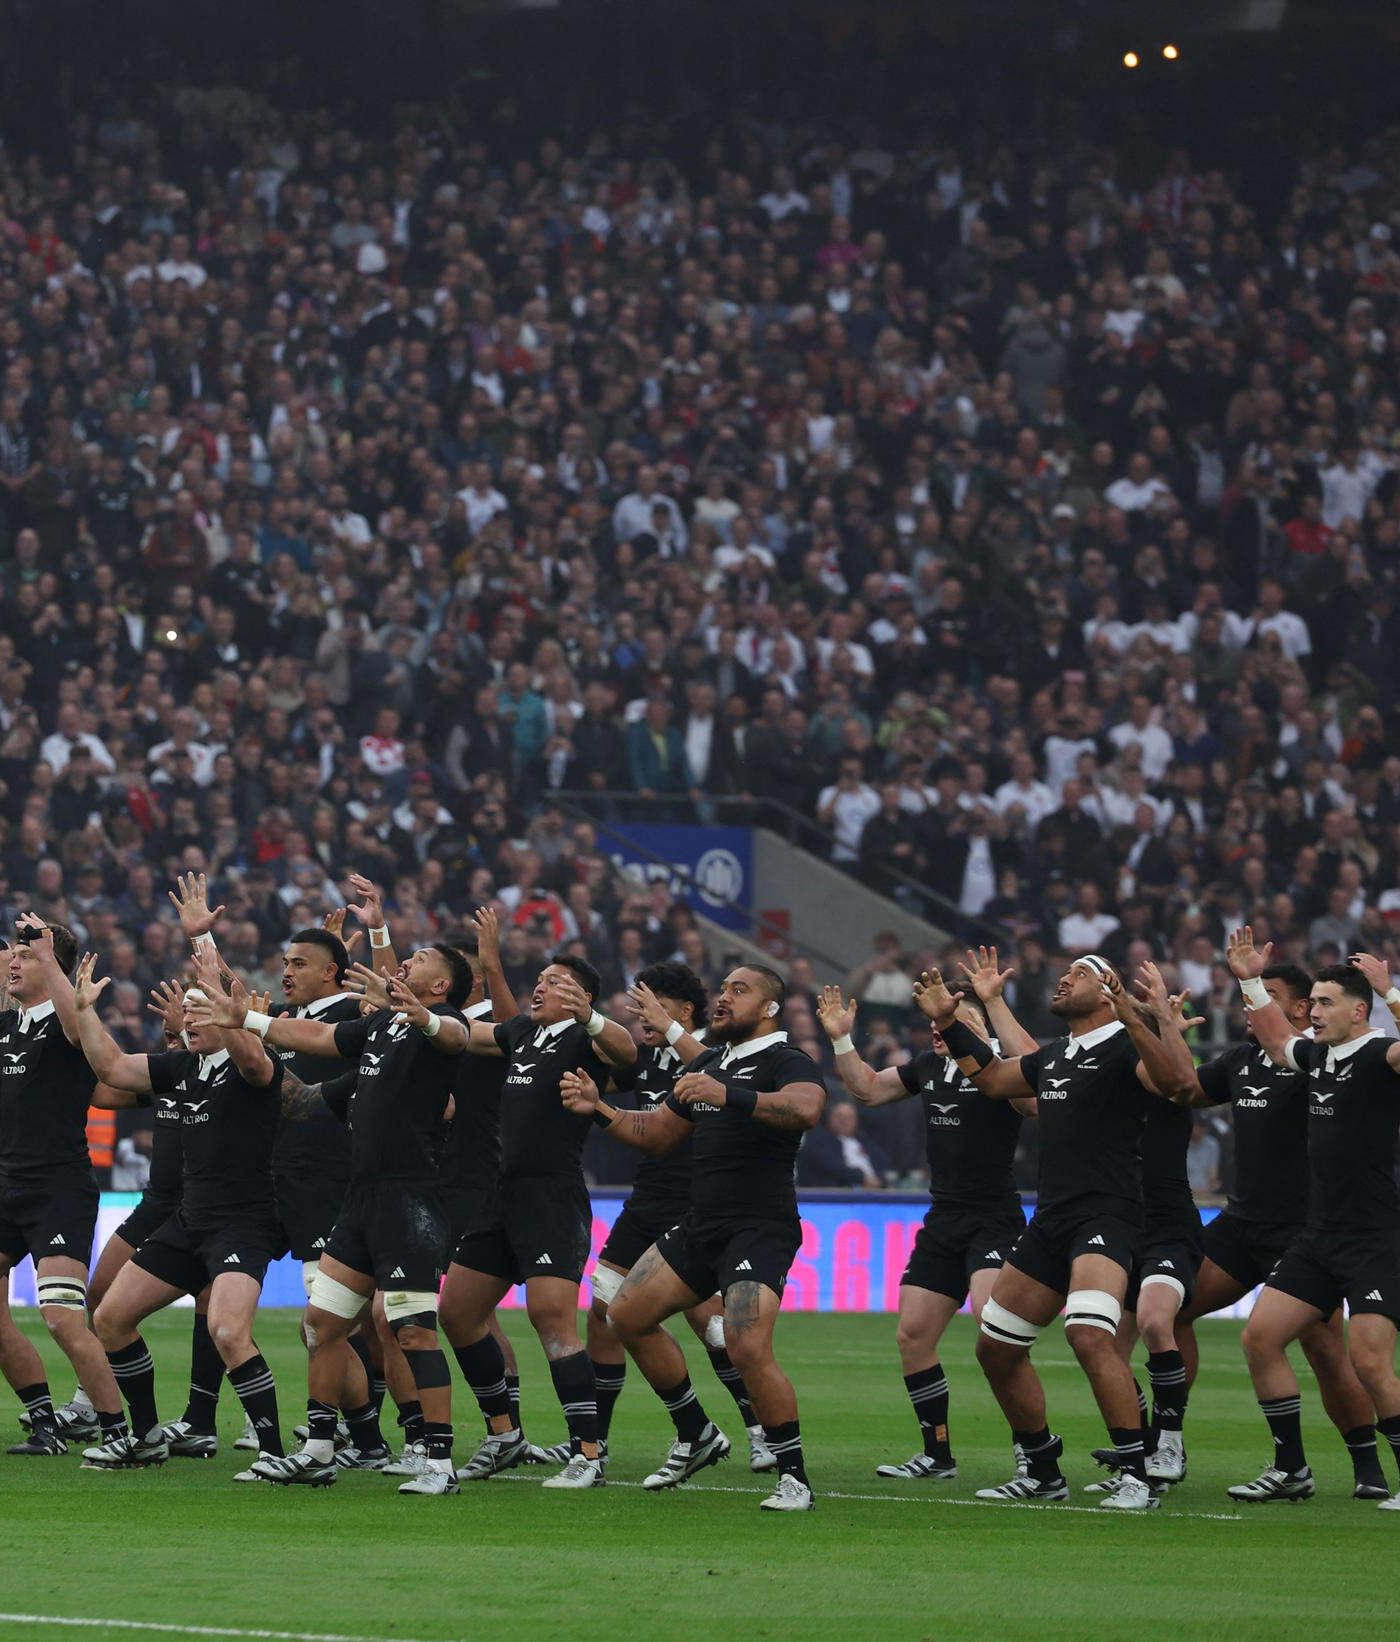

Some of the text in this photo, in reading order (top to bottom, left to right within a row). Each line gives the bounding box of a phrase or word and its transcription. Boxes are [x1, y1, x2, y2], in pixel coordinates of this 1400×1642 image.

[2, 1065, 26, 1075] ALTRAD
[506, 1075, 533, 1084] ALTRAD
[1040, 1091, 1067, 1100] ALTRAD
[1236, 1098, 1267, 1108] ALTRAD
[156, 1110, 180, 1120] ALTRAD
[182, 1113, 209, 1125] ALTRAD
[929, 1116, 960, 1126] ALTRAD
